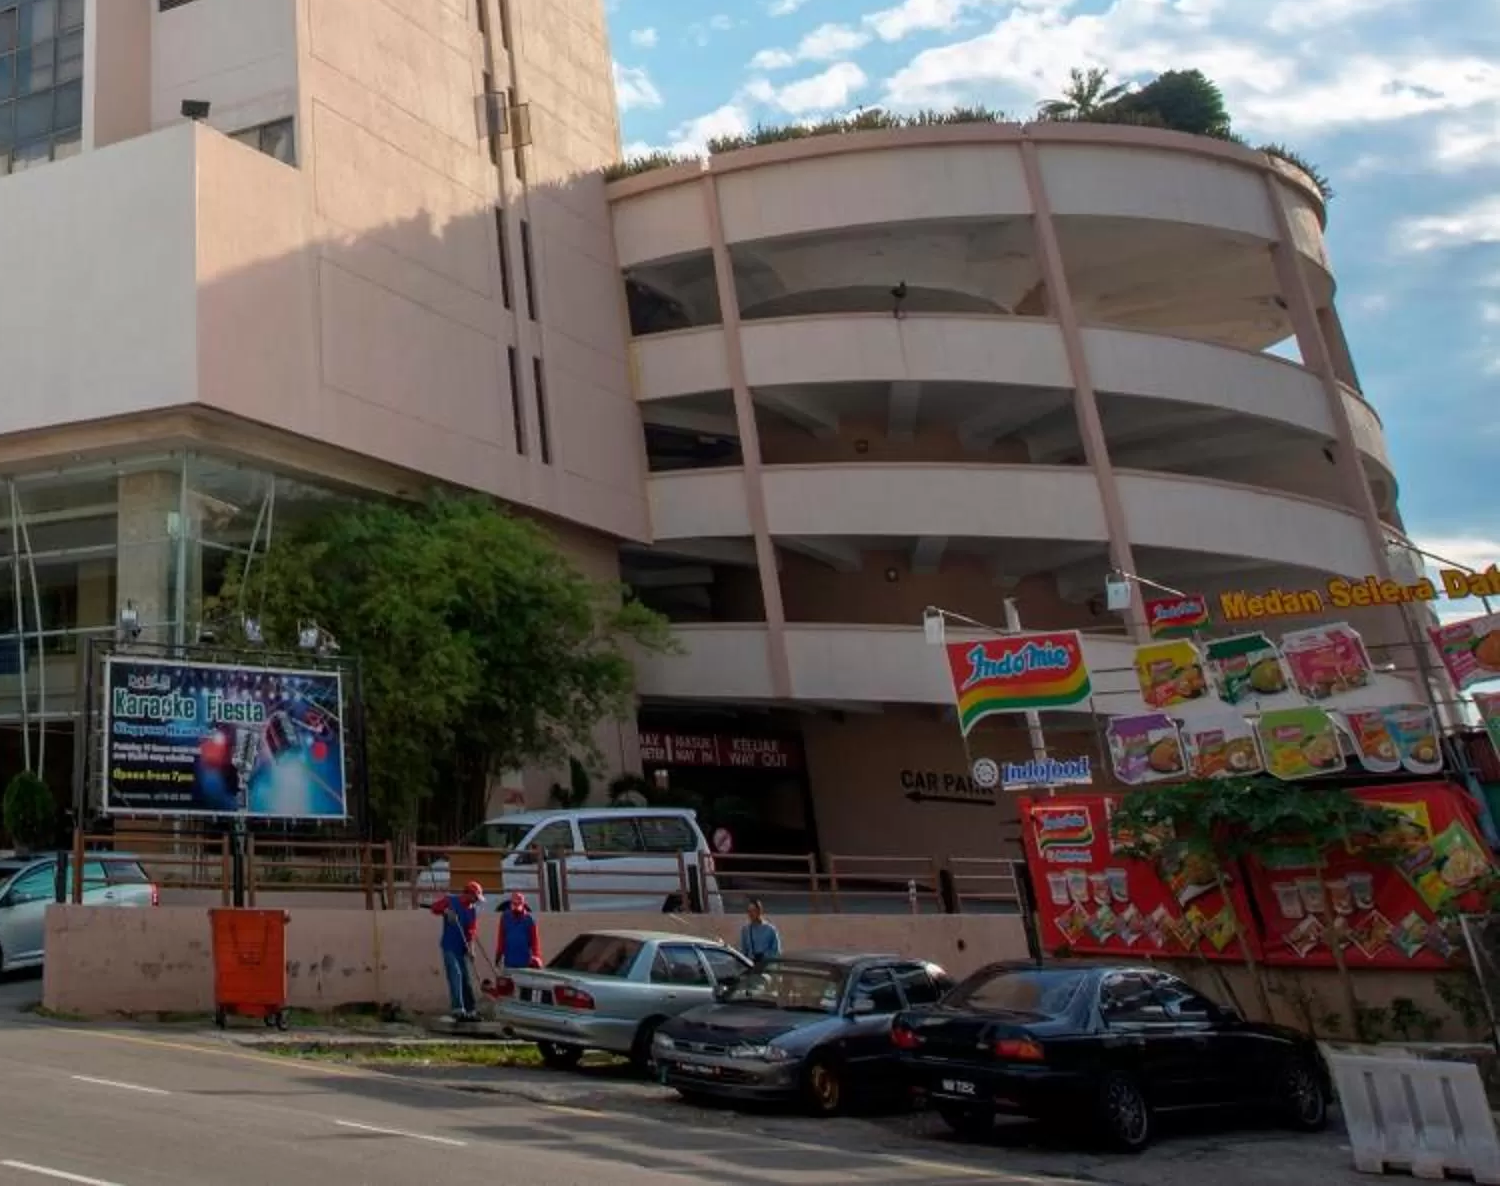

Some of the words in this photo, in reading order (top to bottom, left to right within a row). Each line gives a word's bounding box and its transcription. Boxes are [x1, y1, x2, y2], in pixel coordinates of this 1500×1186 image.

[1220, 588, 1324, 621] Medan
[1327, 575, 1435, 607] Selera
[960, 641, 1070, 691] Indomie
[114, 687, 197, 720] Karaoke
[206, 694, 265, 723] Fiesta
[729, 752, 755, 766] WAY
[761, 753, 787, 766] OUT
[1002, 755, 1090, 785] Indofood
[901, 769, 937, 791] CAR
[943, 773, 994, 795] PAR
